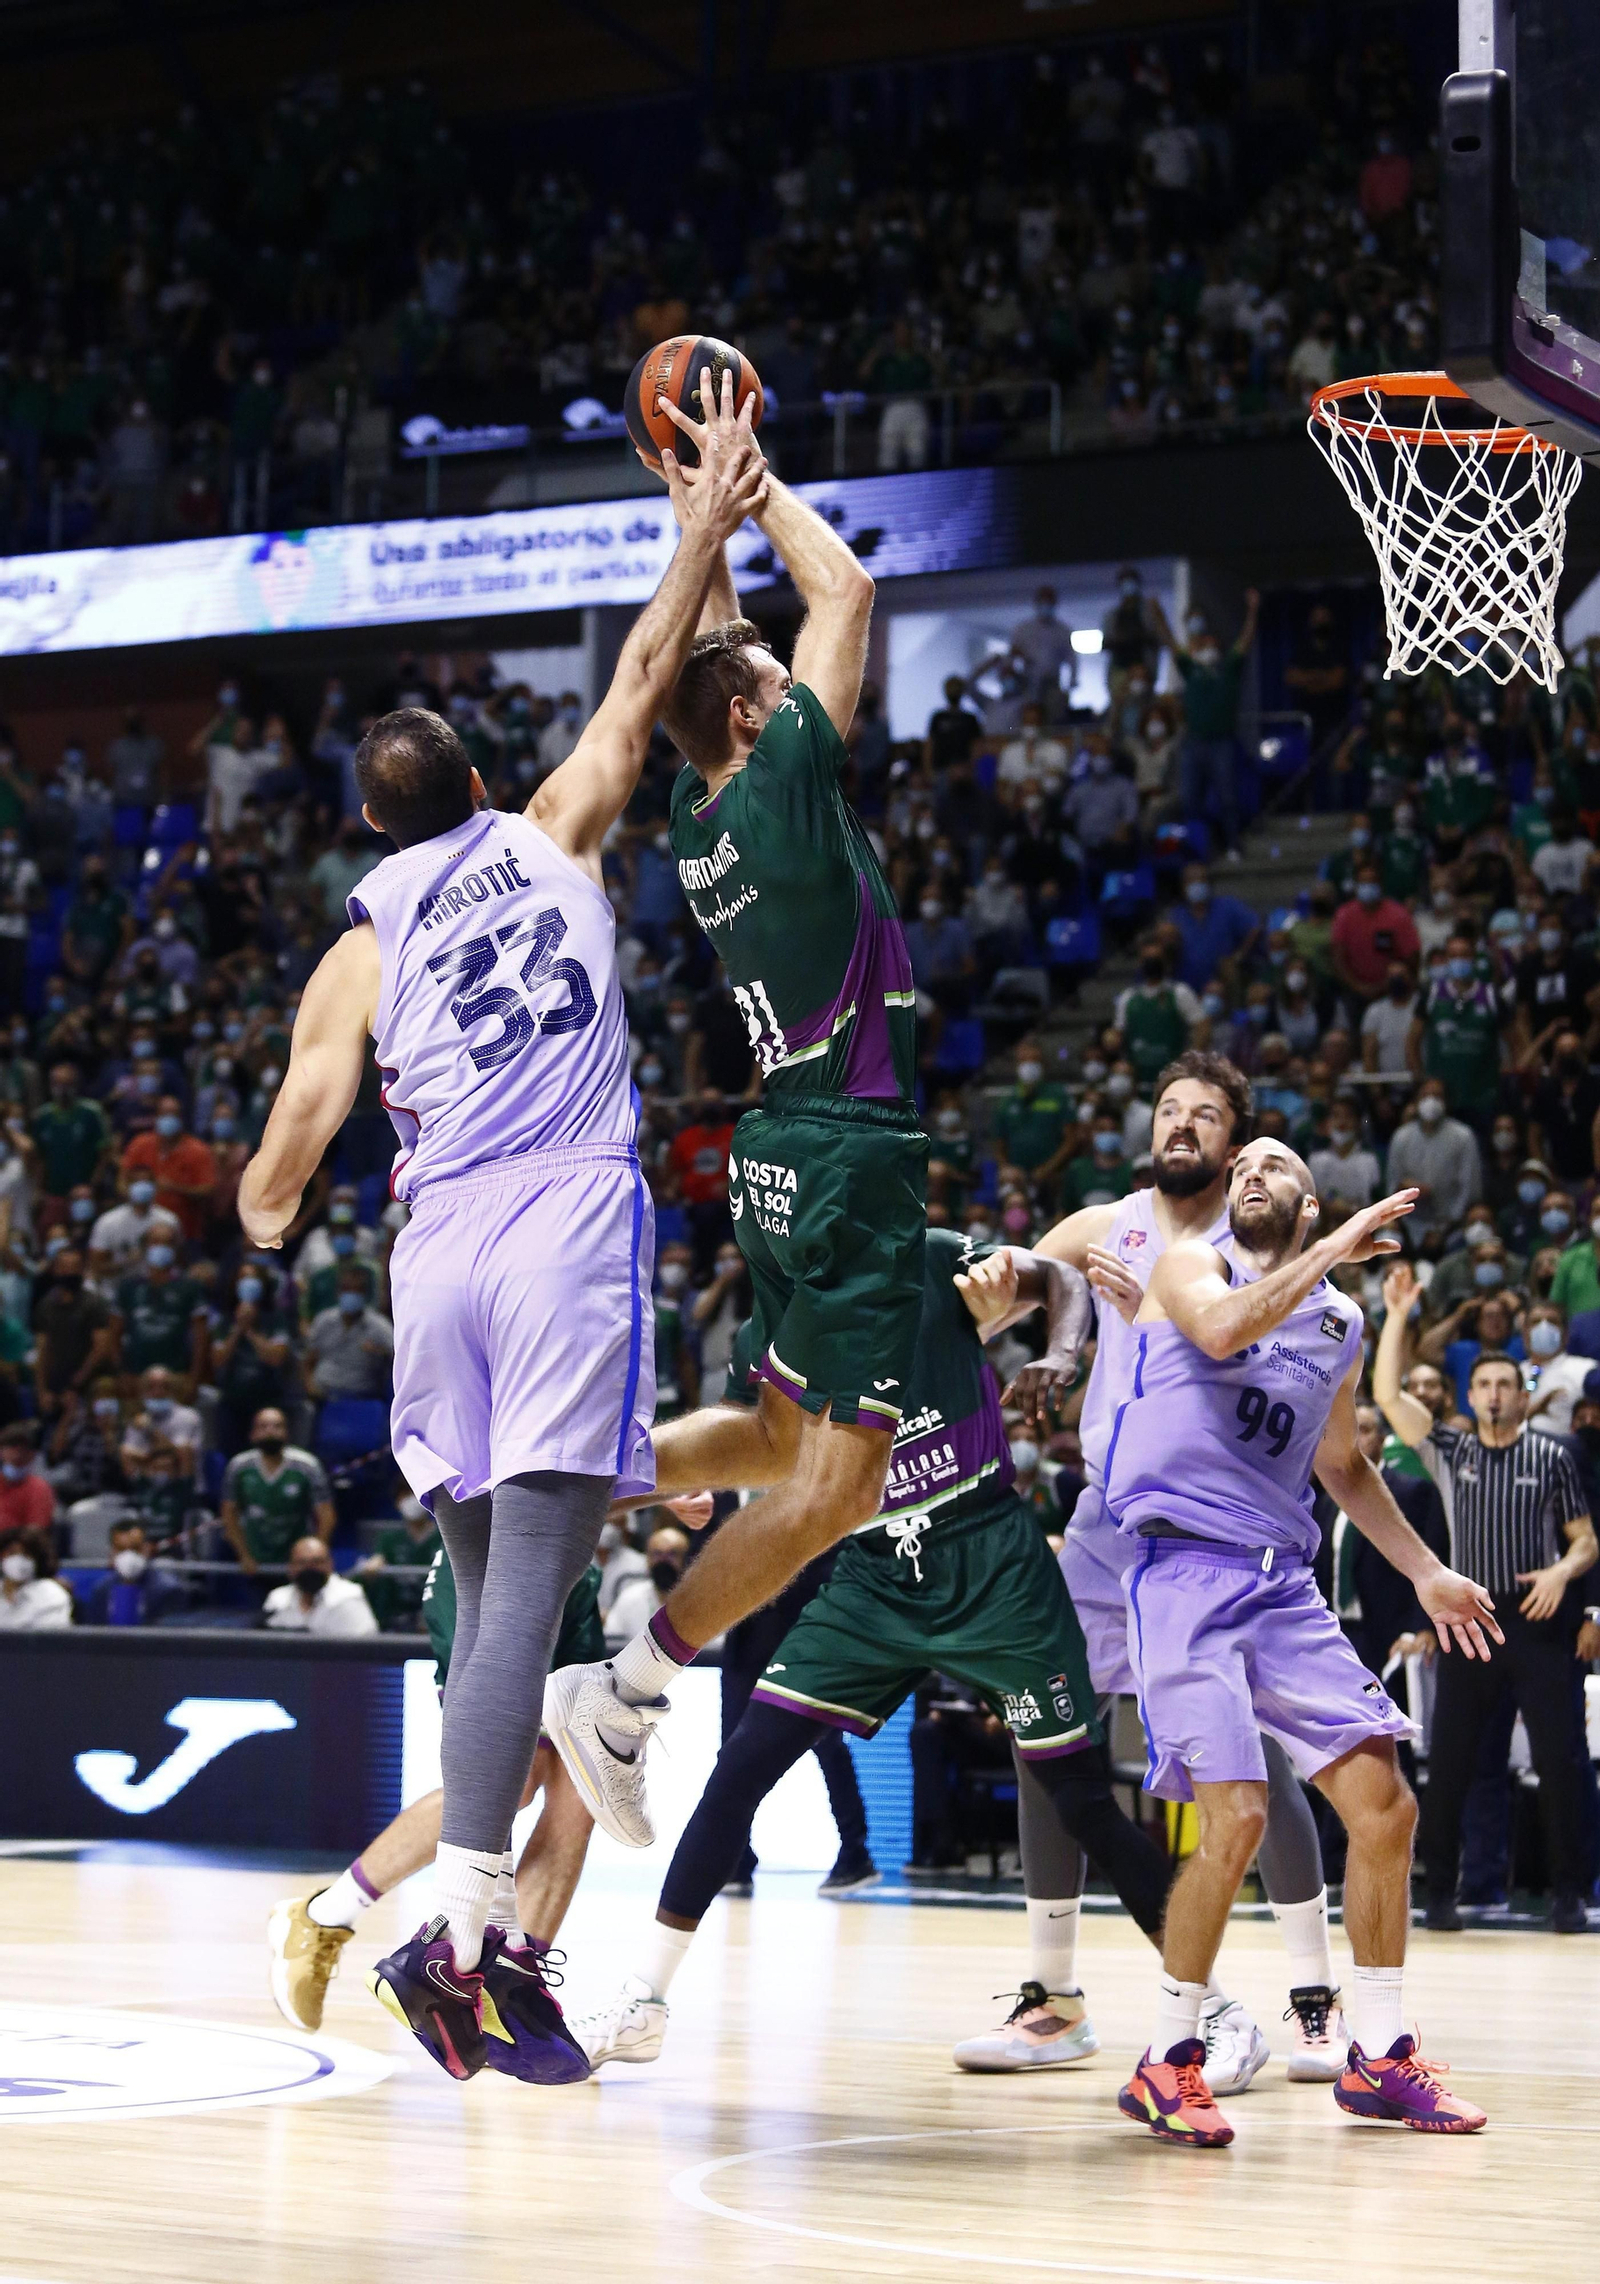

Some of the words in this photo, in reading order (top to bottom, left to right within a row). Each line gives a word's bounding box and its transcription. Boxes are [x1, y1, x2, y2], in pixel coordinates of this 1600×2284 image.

[624, 518, 661, 543] de
[418, 848, 532, 931] MIROTIĆ
[426, 907, 598, 1073] 33
[743, 1157, 798, 1193] COSTA
[747, 1183, 761, 1207] EL
[764, 1191, 793, 1216] SOL
[754, 1206, 790, 1238] LAGA
[894, 1406, 942, 1439] nicaja
[1236, 1386, 1296, 1458] 99
